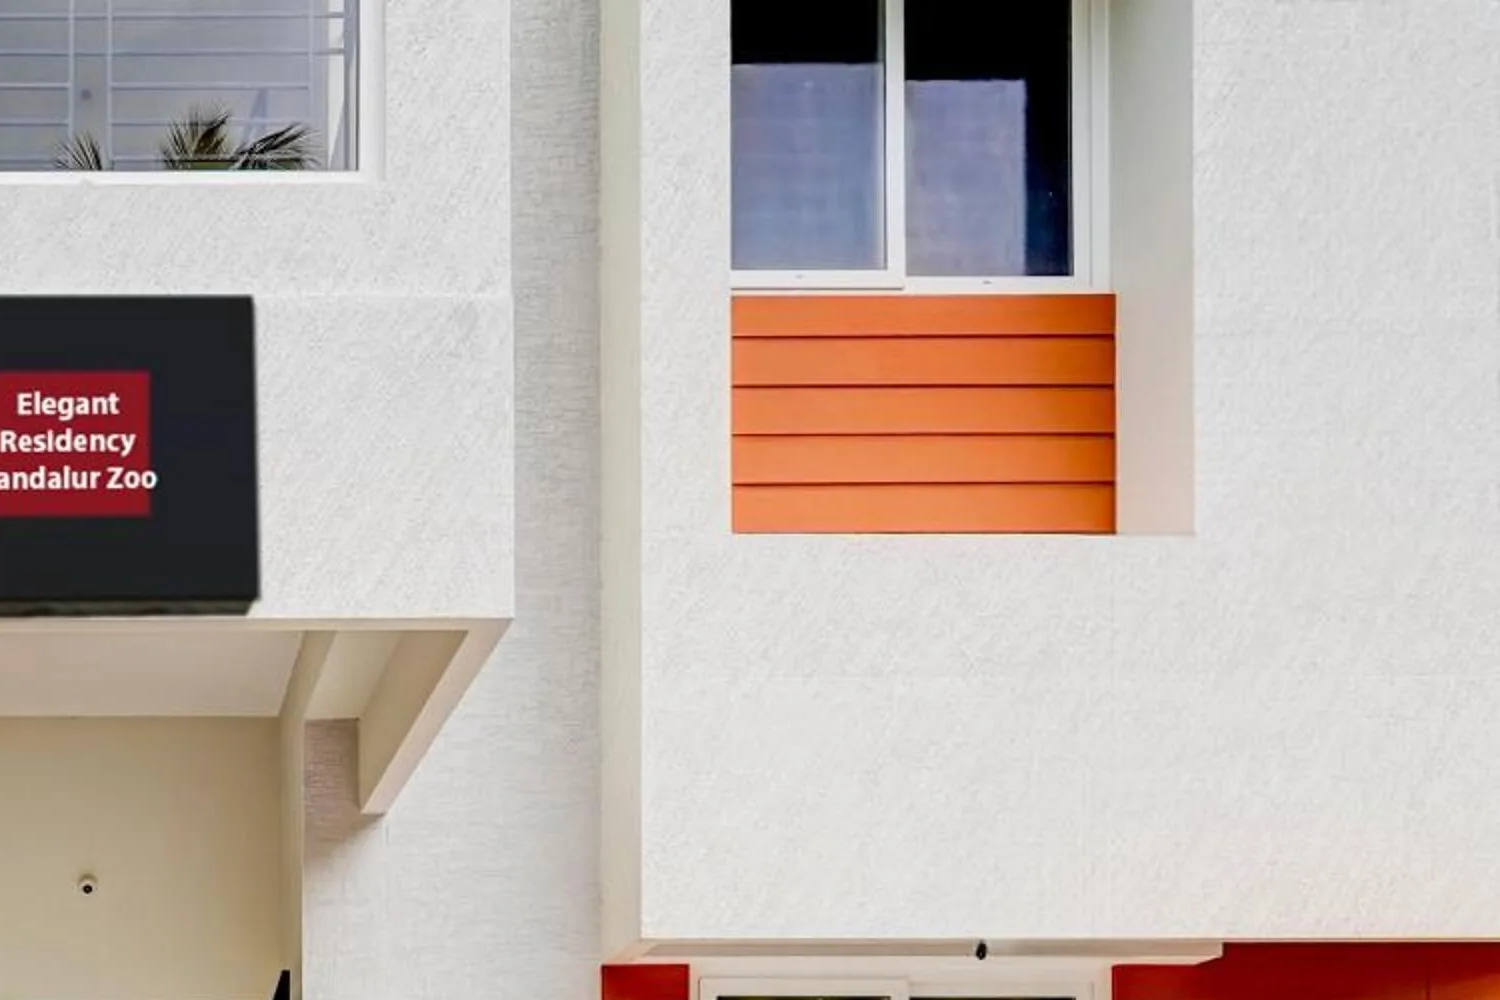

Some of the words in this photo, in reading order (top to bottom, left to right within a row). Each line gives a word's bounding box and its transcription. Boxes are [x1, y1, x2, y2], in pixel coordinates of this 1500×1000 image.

[17, 391, 120, 421] Elegant
[0, 428, 136, 457] Residency
[106, 467, 157, 490] Zoo
